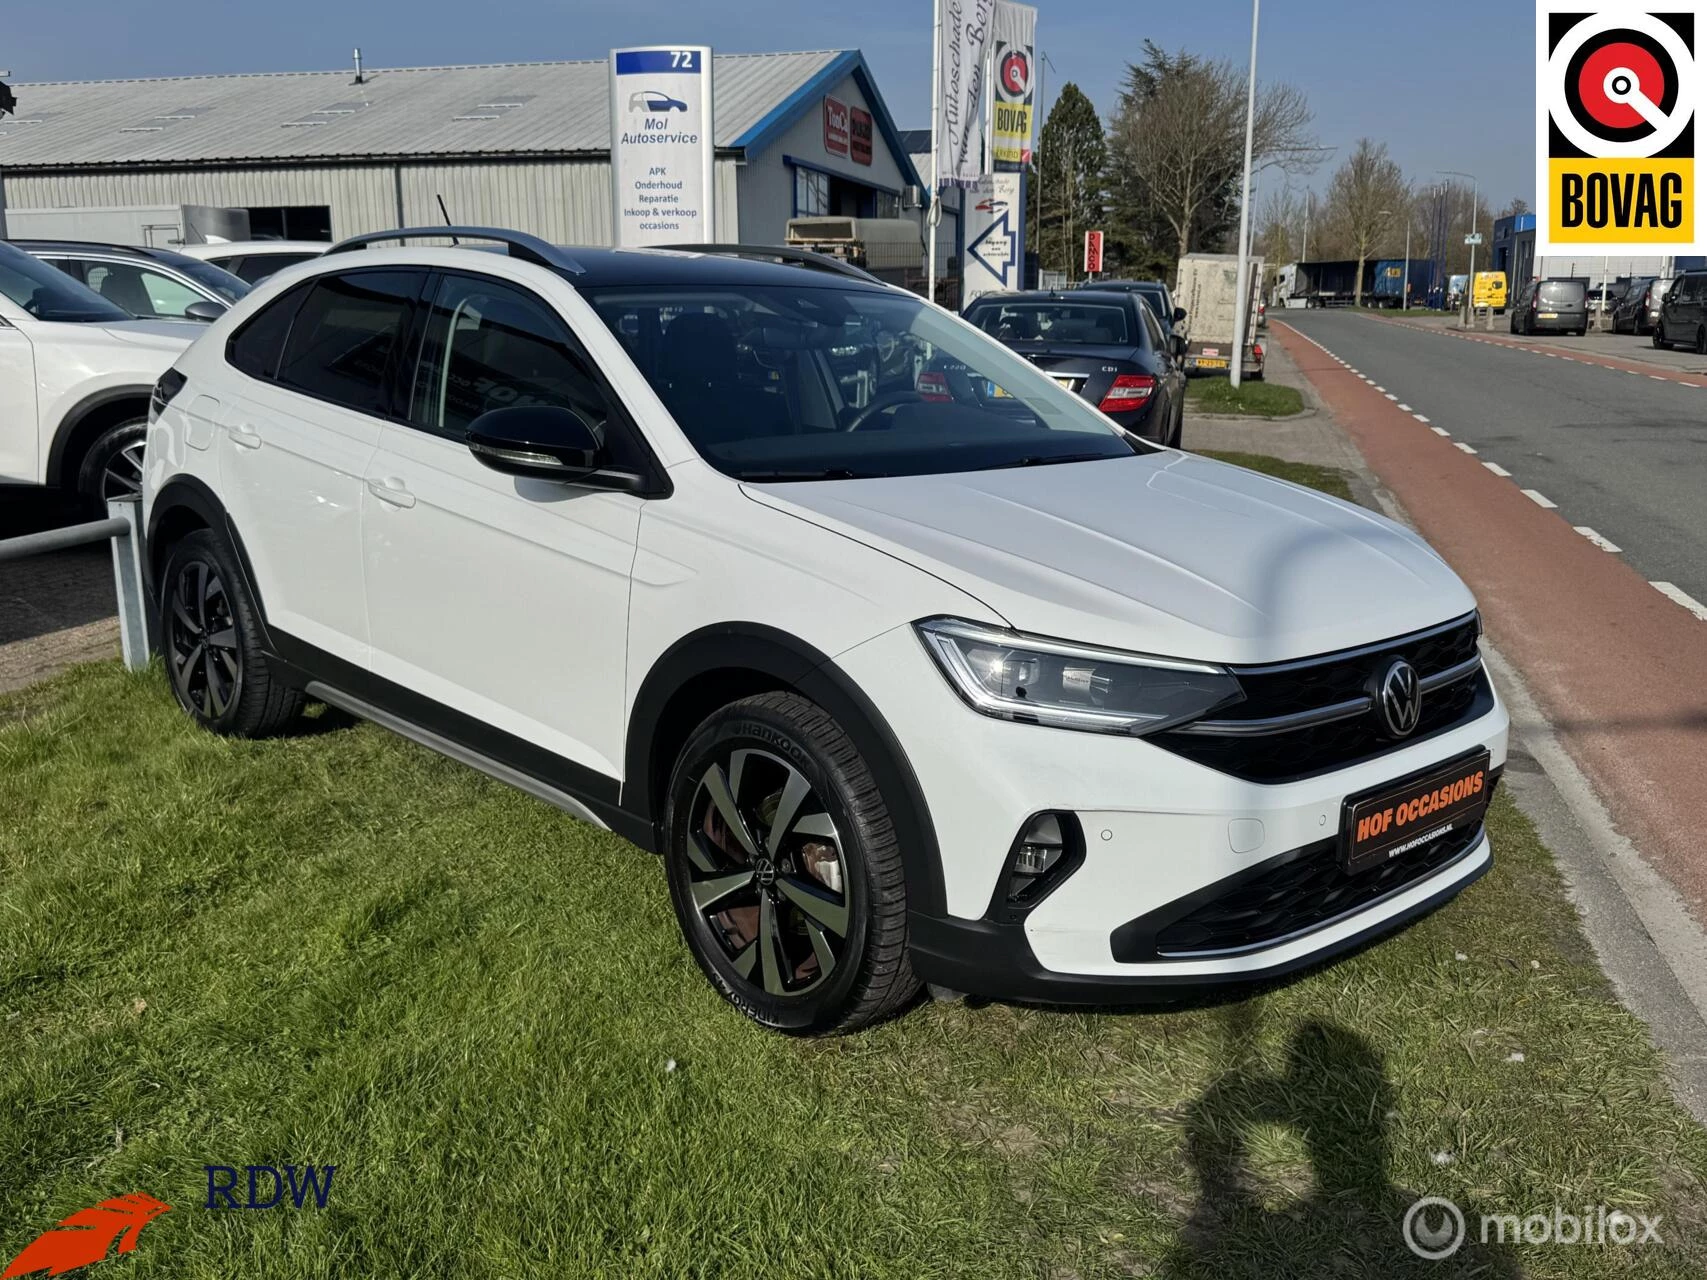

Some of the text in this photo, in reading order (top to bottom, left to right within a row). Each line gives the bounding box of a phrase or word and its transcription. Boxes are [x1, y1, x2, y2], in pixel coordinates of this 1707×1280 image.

[670, 51, 693, 68] 72
[644, 117, 668, 131] Mol
[997, 107, 1027, 134] BOVAG
[621, 131, 698, 145] Autoservice
[649, 167, 666, 176] APK
[635, 180, 683, 190] Onderhoud
[639, 194, 679, 205] Reparatie
[624, 207, 697, 219] Inkoop & verkoop
[639, 221, 680, 230] occasions
[1357, 770, 1484, 842] HOF OCCASIONS
